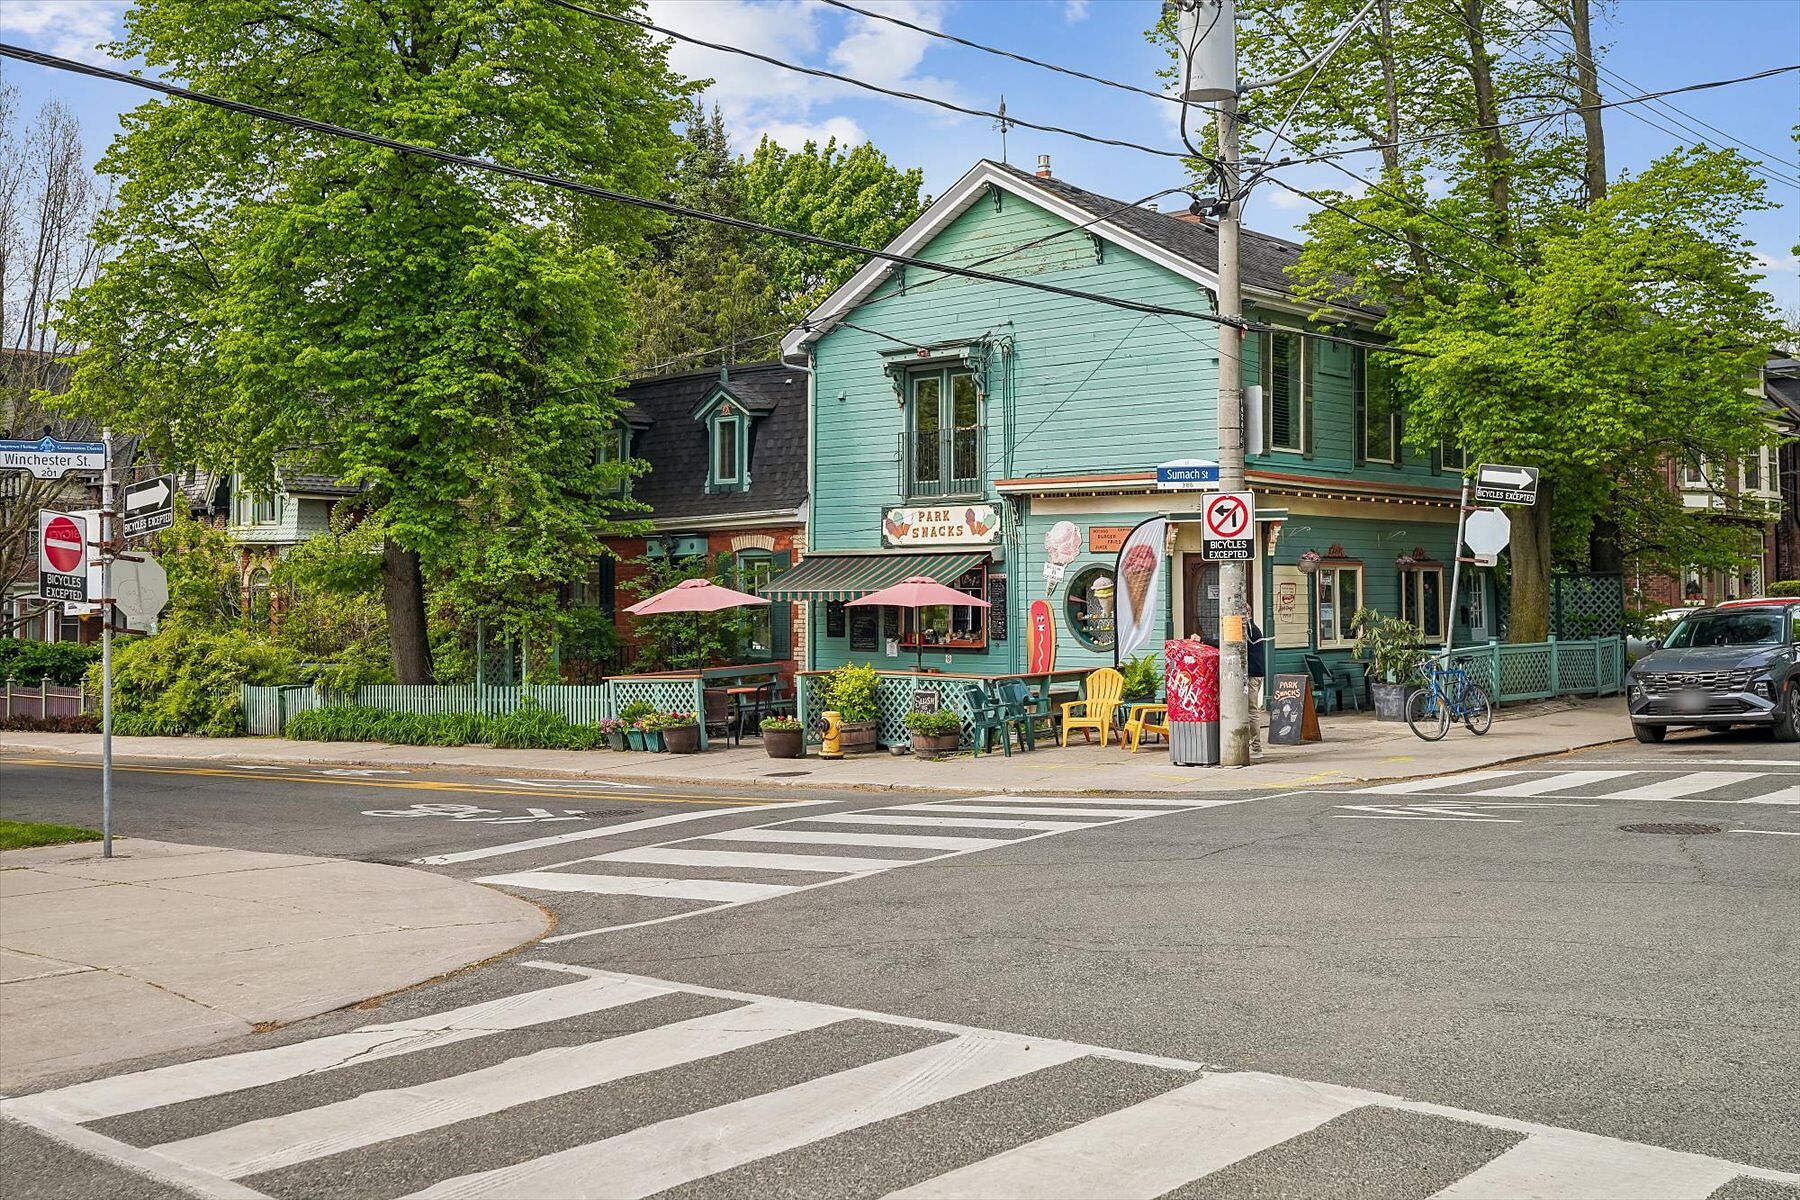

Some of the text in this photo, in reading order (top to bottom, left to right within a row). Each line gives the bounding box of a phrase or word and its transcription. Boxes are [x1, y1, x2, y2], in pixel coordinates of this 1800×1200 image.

[5, 453, 91, 466] Winchester St.
[1167, 469, 1209, 480] Sumach St
[1477, 489, 1535, 502] BICYCLES EXCEPTED
[918, 510, 950, 522] PARK
[125, 513, 172, 532] BICYCLES EXCEPTED
[912, 525, 964, 539] SNACKS
[1210, 540, 1247, 549] BICYCLES
[1209, 550, 1248, 559] EXCEPTED
[47, 573, 81, 588] BICYCLES
[46, 587, 82, 600] EXCEPTED
[1279, 681, 1298, 689] PARK
[1274, 688, 1301, 700] SNACKS
